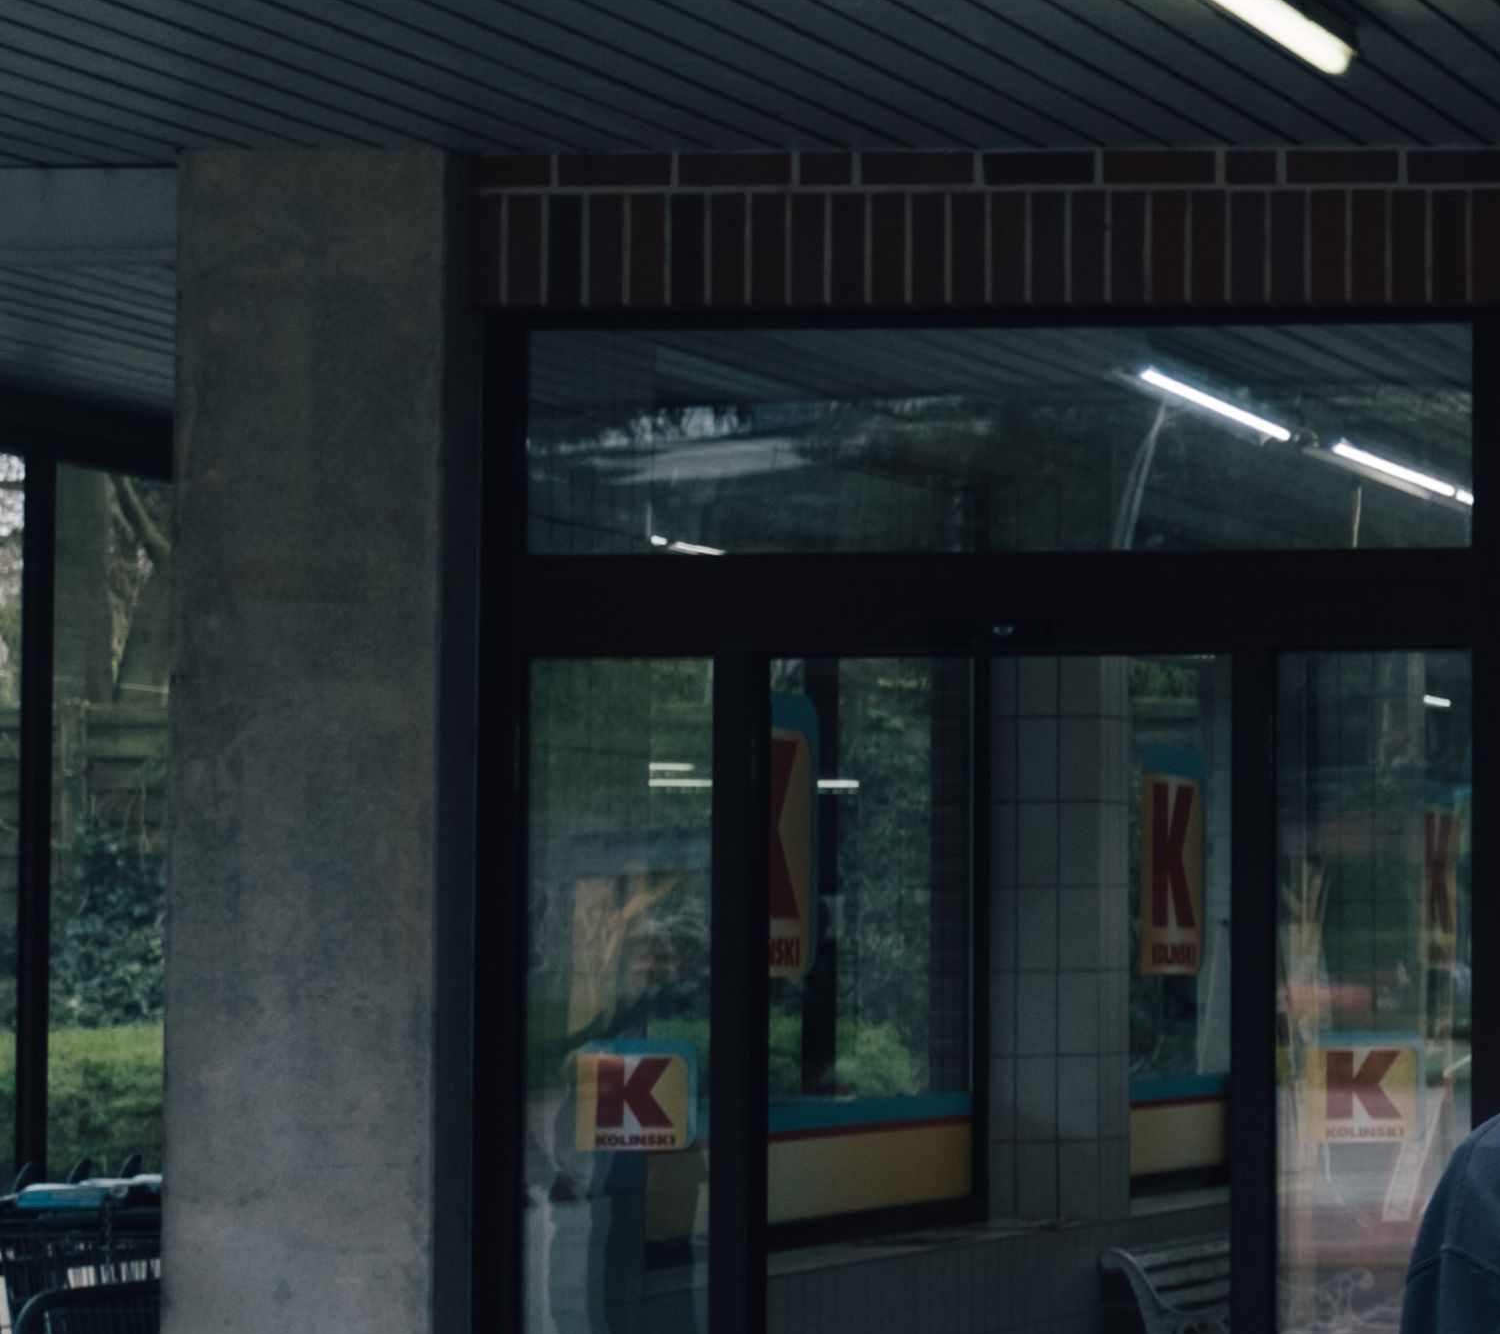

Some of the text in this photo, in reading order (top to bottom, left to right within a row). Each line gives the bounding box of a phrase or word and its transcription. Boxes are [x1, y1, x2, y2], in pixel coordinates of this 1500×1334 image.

[1152, 783, 1195, 927] K
[597, 1057, 674, 1128] K
[1326, 1050, 1402, 1120] K
[595, 1134, 676, 1146] KOLINSKI
[1325, 1127, 1405, 1139] KOLINSKI
